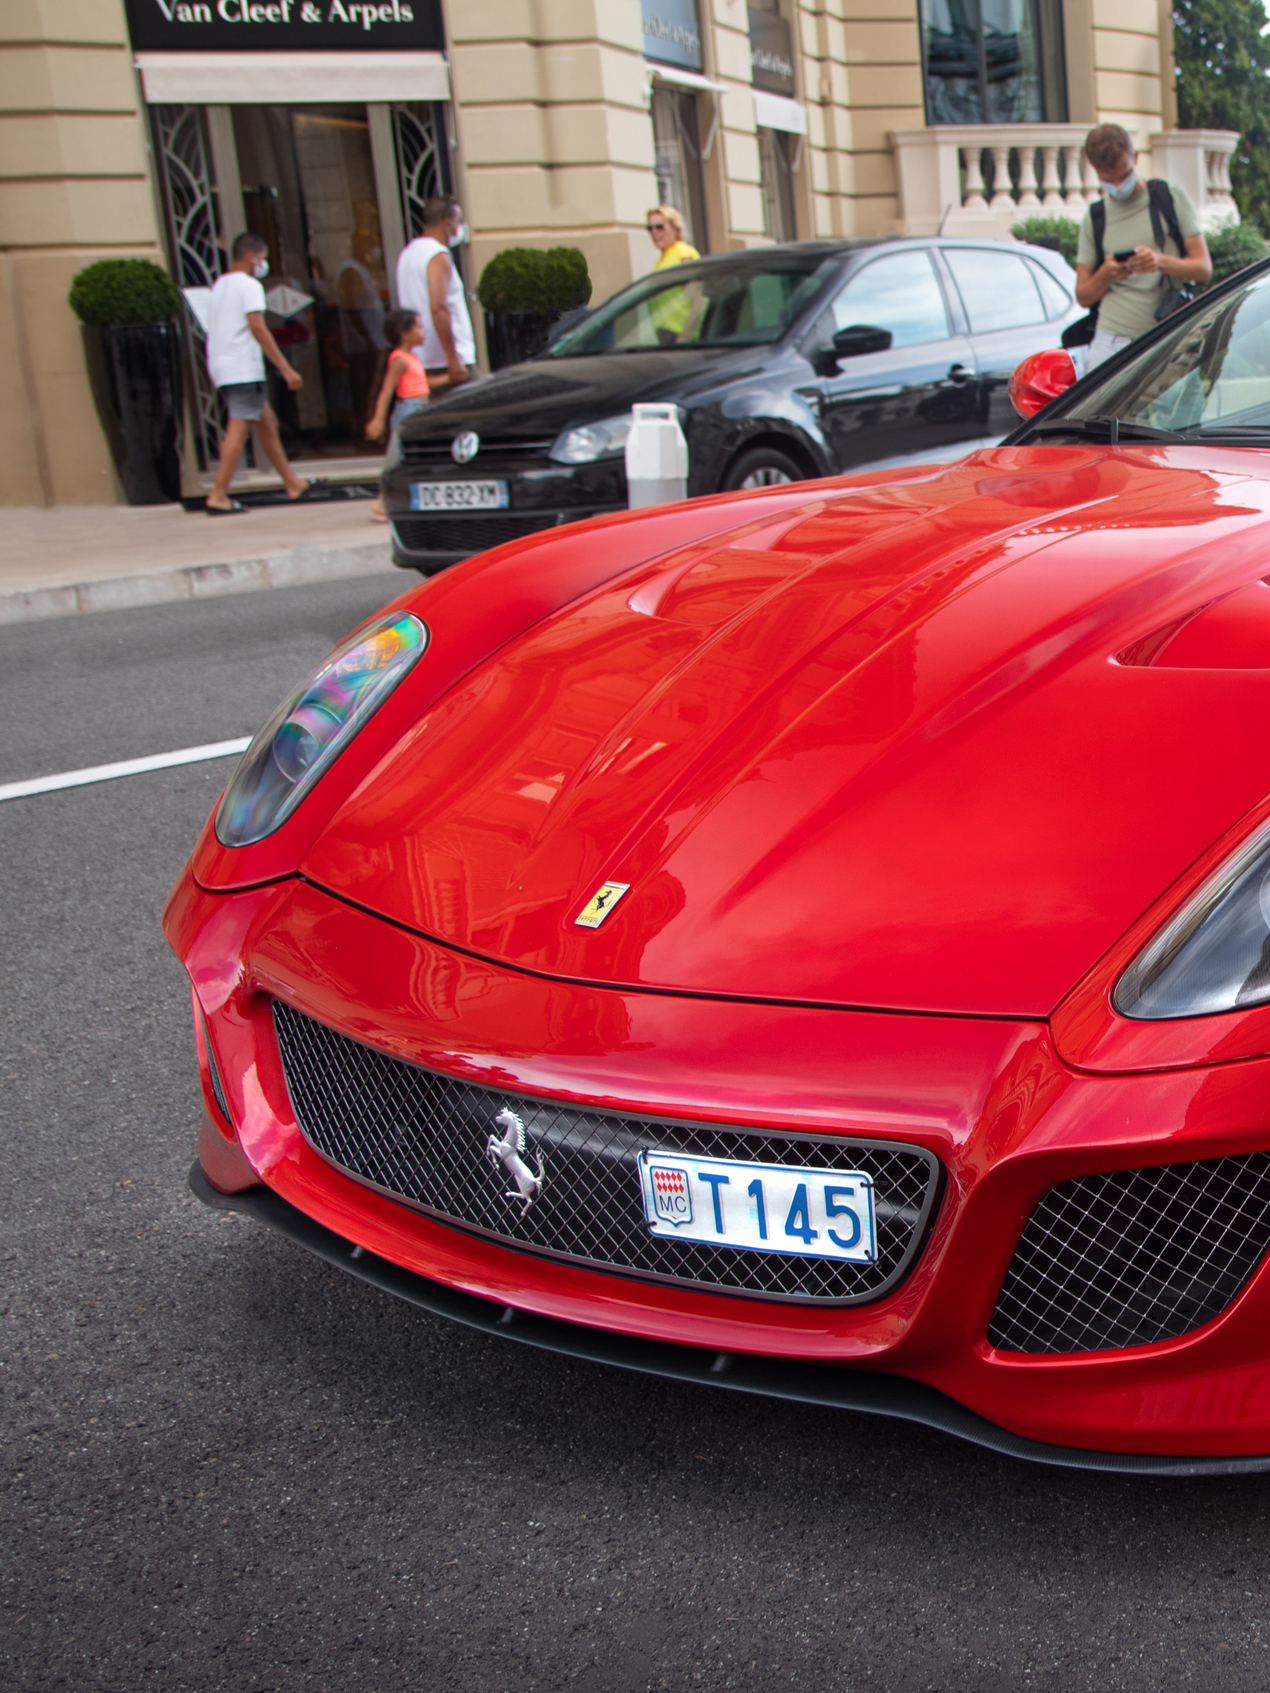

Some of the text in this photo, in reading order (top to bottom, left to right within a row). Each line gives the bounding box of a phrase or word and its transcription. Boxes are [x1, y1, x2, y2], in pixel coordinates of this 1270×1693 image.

[157, 0, 414, 31] Van Cleef & Arpels
[659, 1172, 862, 1249] MC T145
